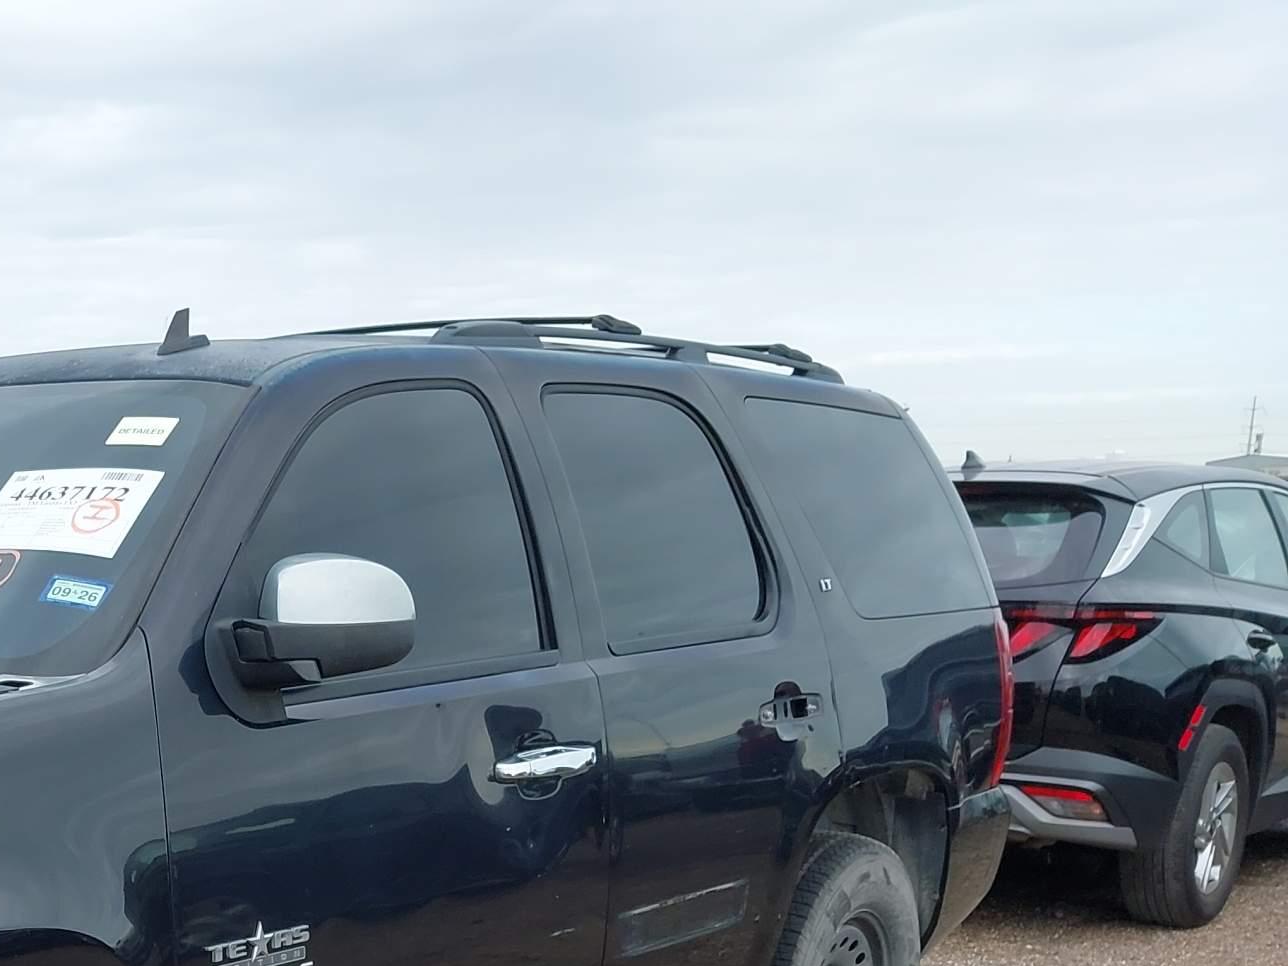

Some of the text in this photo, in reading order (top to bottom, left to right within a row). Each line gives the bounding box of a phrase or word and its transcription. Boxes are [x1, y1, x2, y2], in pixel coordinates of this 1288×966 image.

[10, 485, 130, 503] 44637172
[51, 586, 100, 602] 09 26
[203, 922, 311, 963] TEXAS
